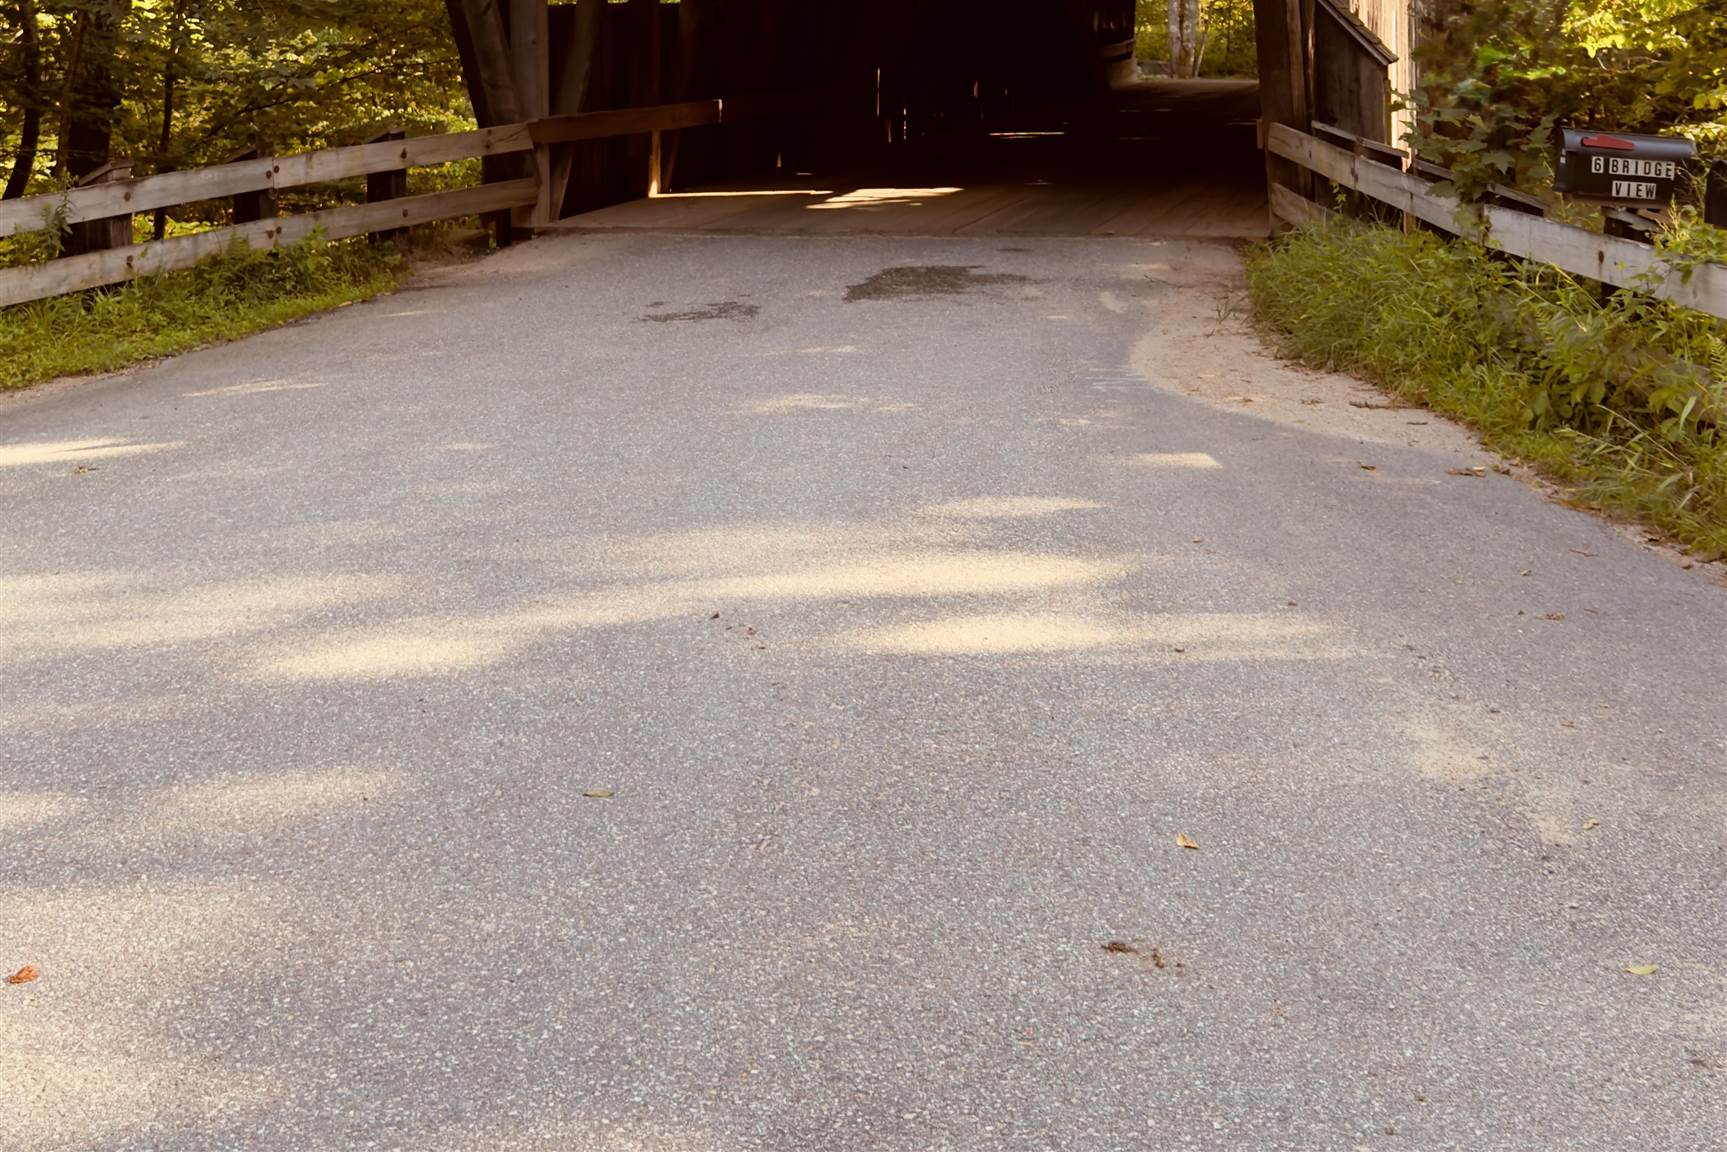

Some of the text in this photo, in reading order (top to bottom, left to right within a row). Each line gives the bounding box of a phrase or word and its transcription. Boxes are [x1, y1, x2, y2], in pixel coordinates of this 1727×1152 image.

[1593, 159, 1674, 178] 6 BRIDGE
[1614, 182, 1656, 198] VIEW
